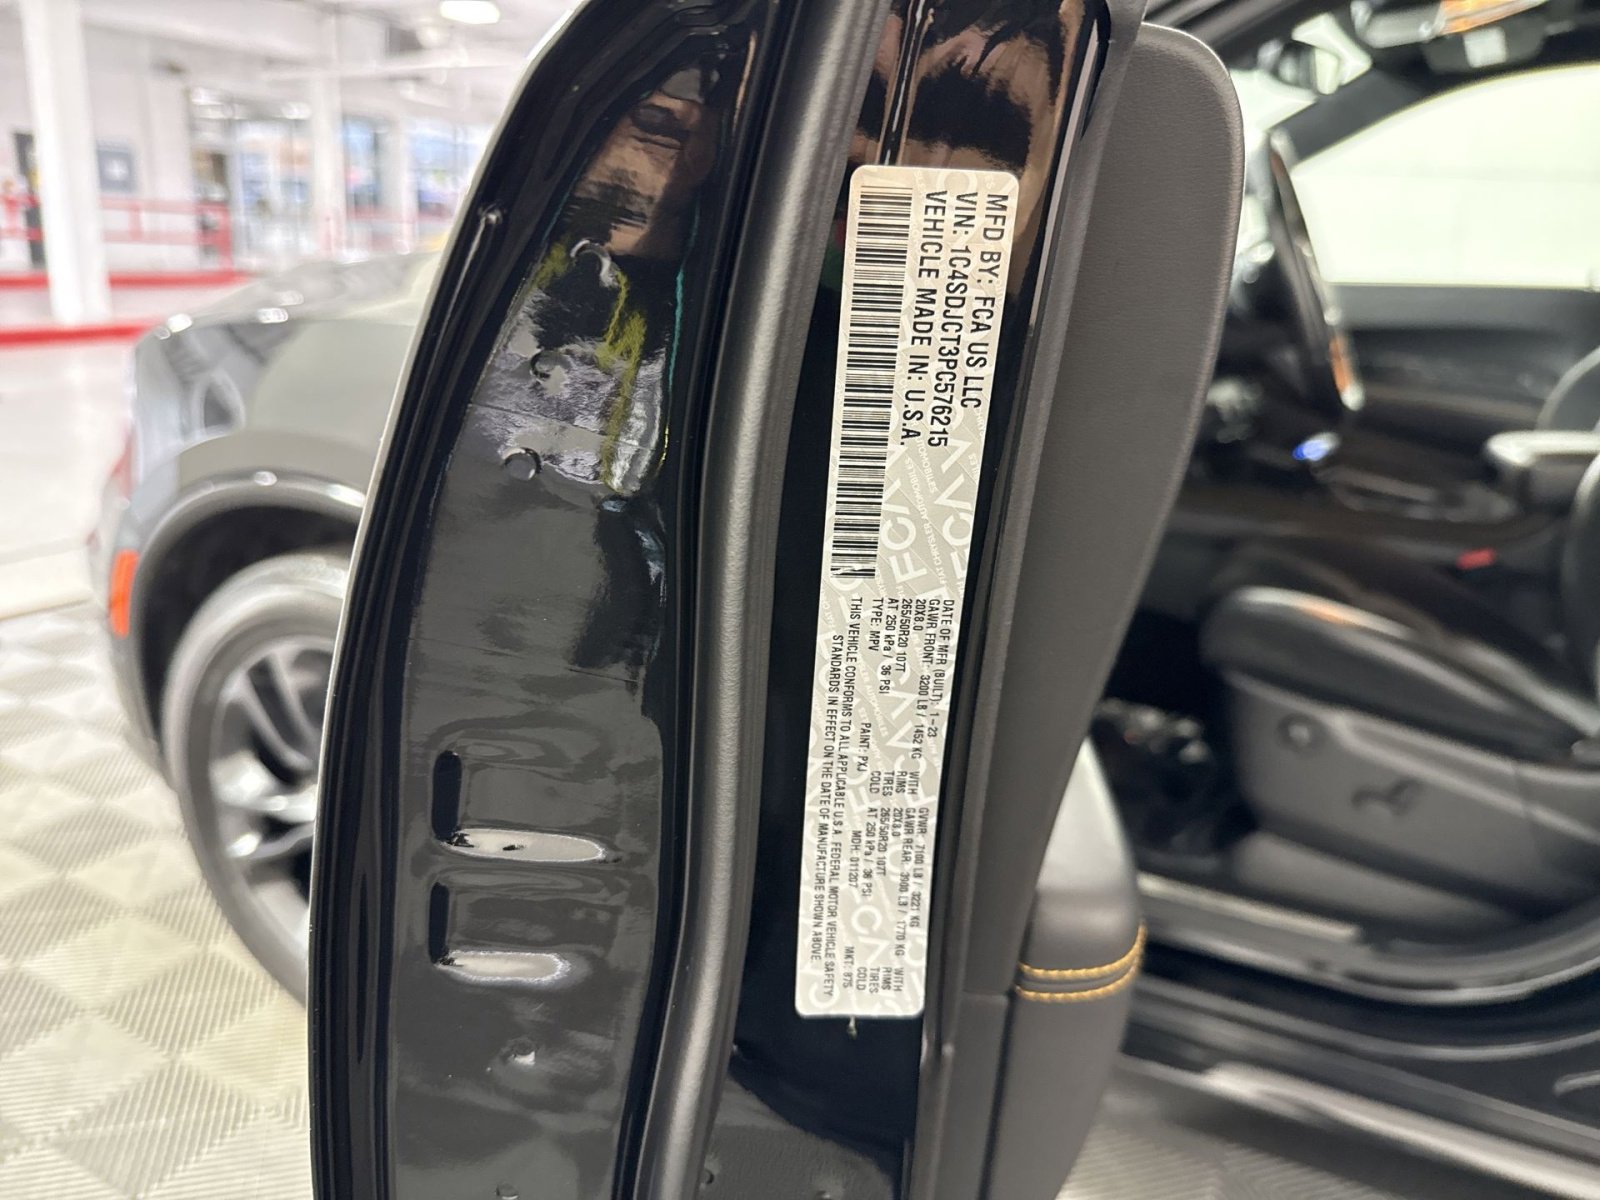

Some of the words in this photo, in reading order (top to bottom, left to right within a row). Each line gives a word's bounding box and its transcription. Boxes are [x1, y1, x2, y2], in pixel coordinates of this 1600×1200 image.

[952, 191, 978, 235] VIN:
[982, 193, 1009, 241] MFD
[917, 190, 948, 279] VEHICLE
[976, 250, 1002, 284] BY:
[910, 287, 937, 346] MADE
[970, 296, 996, 333] FCA
[927, 245, 971, 447] 1C4SDJCT3PC576215
[965, 342, 989, 368] US
[907, 354, 930, 380] IN:
[960, 375, 984, 408] LLC
[899, 389, 926, 446] U.S.A.
[849, 596, 863, 620] THIS
[870, 597, 884, 626] TYPE:
[887, 597, 899, 611] AT
[912, 598, 927, 631] 20X8.0
[925, 598, 941, 629] GAWR
[940, 599, 955, 625] DATE
[884, 614, 897, 631] 250
[897, 597, 913, 648] 265/50R20
[938, 628, 951, 641] OF
[845, 622, 860, 662] VEHICLE
[867, 630, 881, 651] MPV
[882, 634, 895, 651] kPa
[921, 632, 937, 668] FRONT:
[828, 634, 844, 693] STANDARDS
[894, 651, 907, 673] 107T
[935, 644, 949, 665] MFR
[880, 664, 892, 676] 36
[841, 665, 856, 717] CONFORMS
[878, 679, 891, 694] PSI
[917, 674, 931, 696] 3200
[928, 668, 945, 705] (BUILT):
[827, 696, 838, 706] IN
[916, 699, 928, 710] LB
[824, 708, 838, 742] EFFECT
[839, 719, 852, 732] TO
[858, 722, 872, 752] PAINT:
[912, 723, 924, 744] 1452
[823, 745, 835, 758] ON
[837, 734, 850, 752] ALL
[910, 746, 922, 759] KG
[821, 760, 834, 778] THE
[856, 755, 869, 772] PXJ
[833, 753, 849, 807] APPLICABLE
[868, 770, 881, 794] COLD
[881, 770, 895, 797] TIRES
[894, 770, 908, 794] RIMS
[907, 770, 920, 795] WITH
[819, 781, 832, 805] DATE
[818, 807, 830, 819] OF
[867, 807, 878, 818] AT
[903, 807, 916, 835] GAWR
[917, 807, 930, 837] GVWR:
[850, 830, 862, 853] MDH:
[865, 821, 876, 837] 250
[813, 822, 829, 891] MANUFACTURE
[863, 839, 875, 856] kPa
[900, 837, 914, 864] REAR:
[913, 844, 925, 865] 7100
[828, 841, 842, 883] FEDERAL
[847, 856, 860, 888] 011207
[875, 855, 887, 876] 107T
[827, 885, 839, 917] MOTOR
[861, 882, 873, 897] PSI
[910, 891, 921, 911] 3221
[812, 893, 825, 928] SHOWN
[909, 915, 920, 927] KG
[824, 920, 837, 958] VEHICLE
[895, 920, 906, 941] 1770
[843, 946, 855, 968] MKT:
[894, 943, 905, 956] KG
[823, 960, 835, 996] SAFETY
[855, 966, 868, 991] COLD
[868, 966, 880, 994] TIRES
[880, 966, 892, 990] RIMS
[893, 967, 904, 992] WITH
